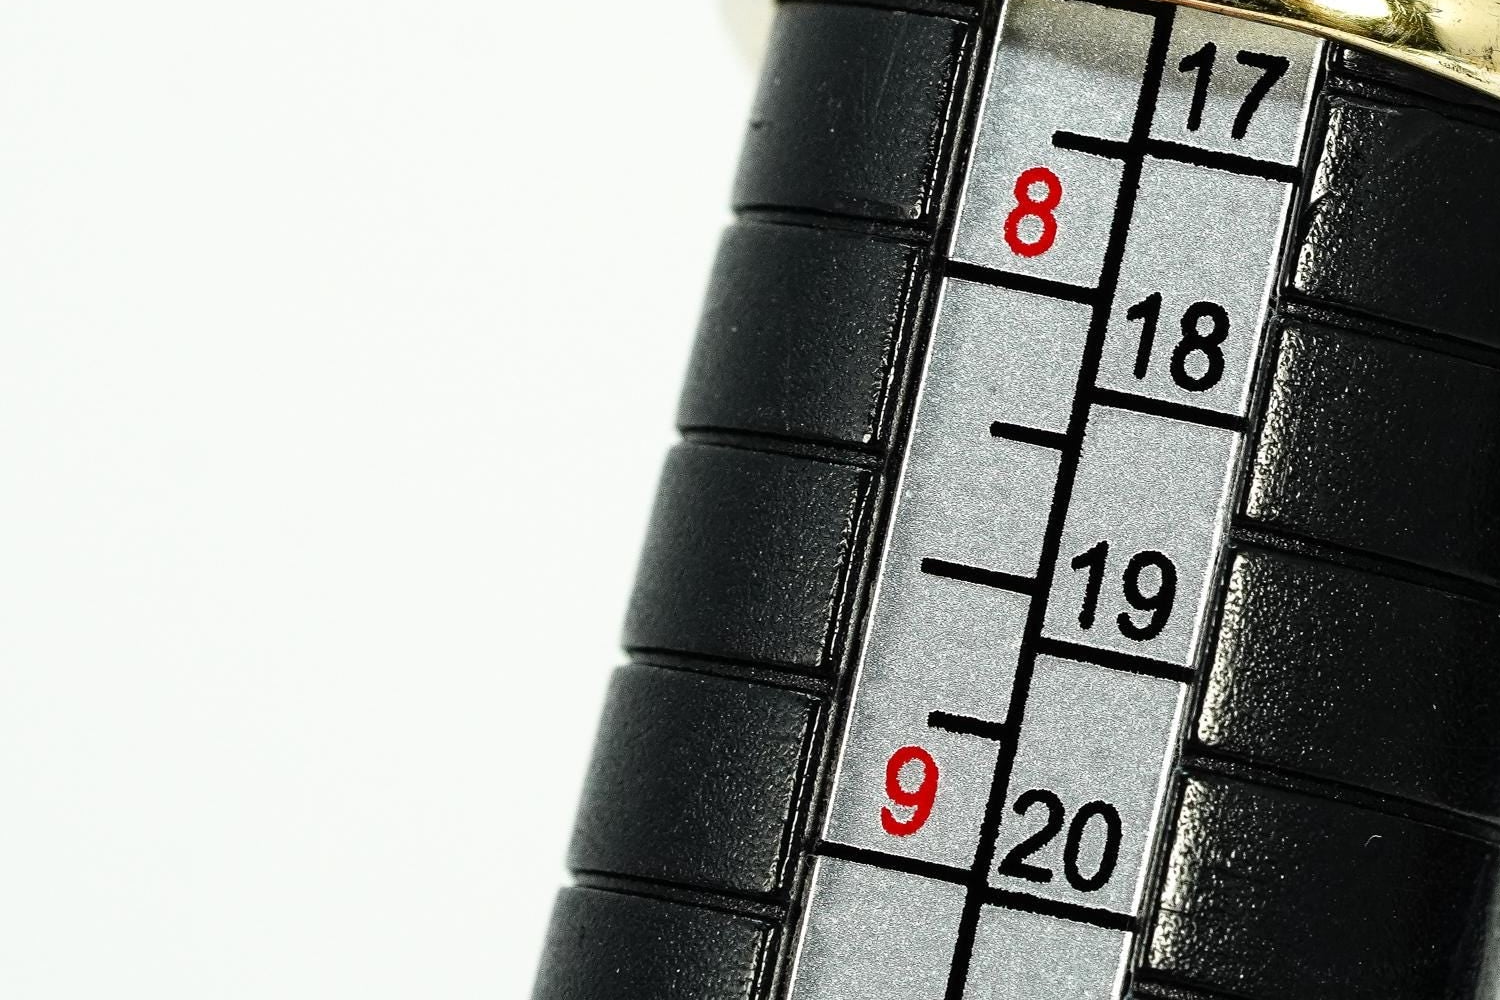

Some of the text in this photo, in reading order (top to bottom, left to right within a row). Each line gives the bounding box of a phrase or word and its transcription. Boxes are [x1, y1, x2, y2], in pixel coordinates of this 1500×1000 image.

[1177, 41, 1291, 142] 17
[1003, 166, 1064, 259] 8
[1125, 291, 1231, 393] 18
[1070, 540, 1179, 643] 19
[880, 745, 940, 838] 9
[997, 788, 1124, 894] 20
